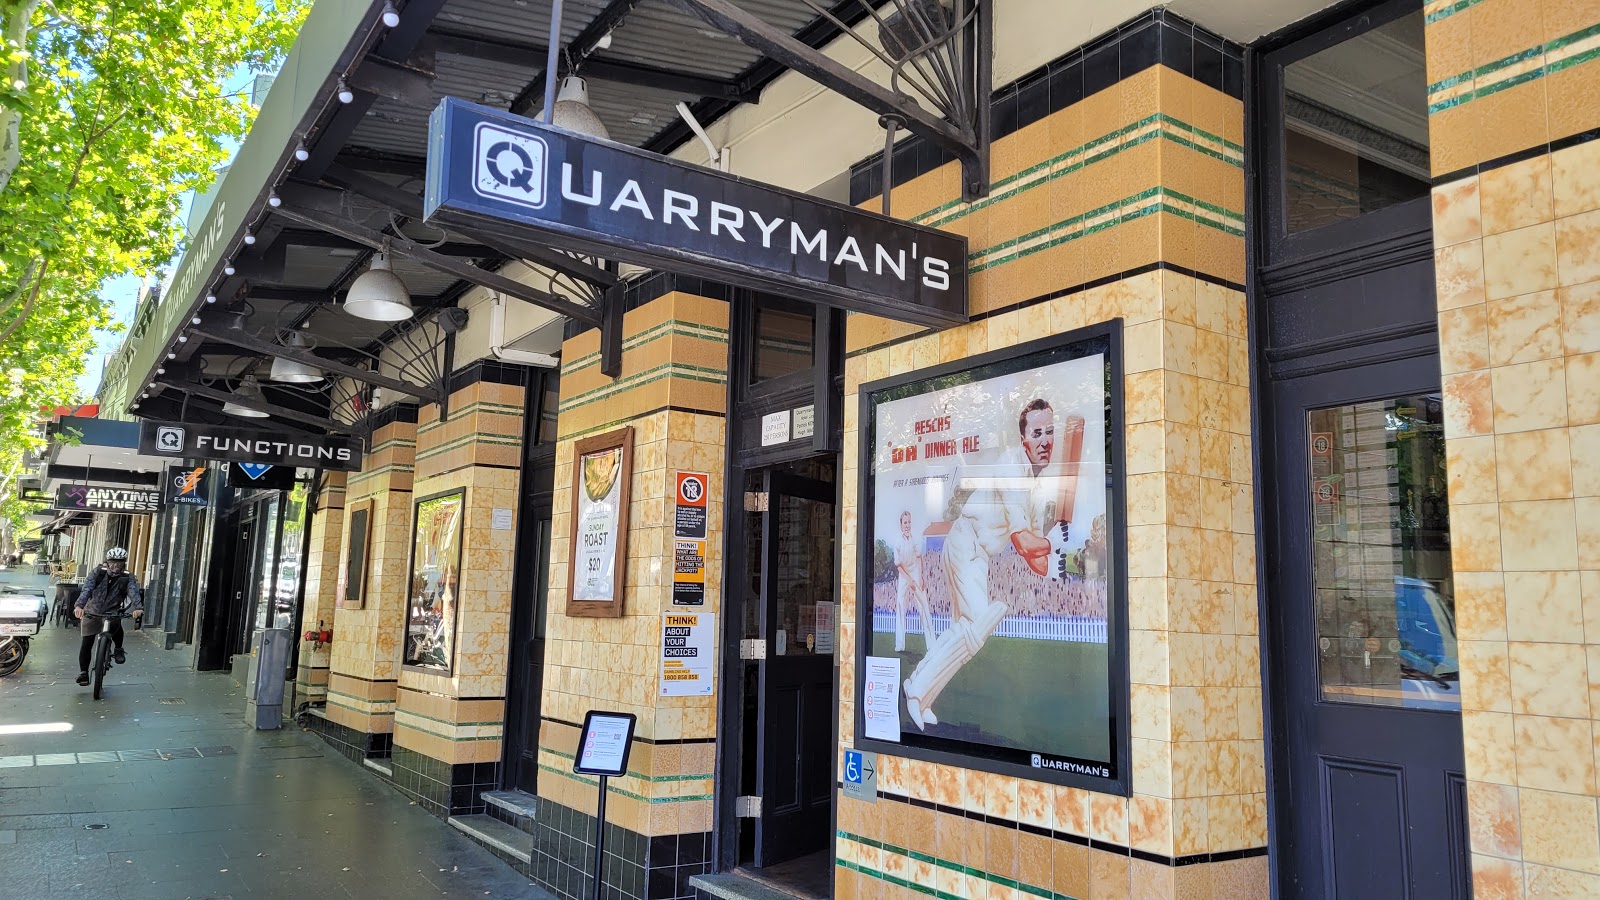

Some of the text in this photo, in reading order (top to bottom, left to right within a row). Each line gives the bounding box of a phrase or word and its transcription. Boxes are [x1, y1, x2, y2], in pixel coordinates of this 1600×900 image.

[196, 435, 351, 461] FUNCTIONS
[924, 439, 958, 459] DINNER
[962, 435, 980, 453] ALE
[86, 488, 160, 503] ANYTIME
[86, 498, 158, 511] FITNESS
[584, 532, 609, 547] ROAST
[588, 557, 601, 573] $20
[667, 616, 697, 625] THINK!
[666, 627, 690, 636] ABOUT
[665, 638, 685, 646] YOUR
[665, 648, 697, 656] CHOICES
